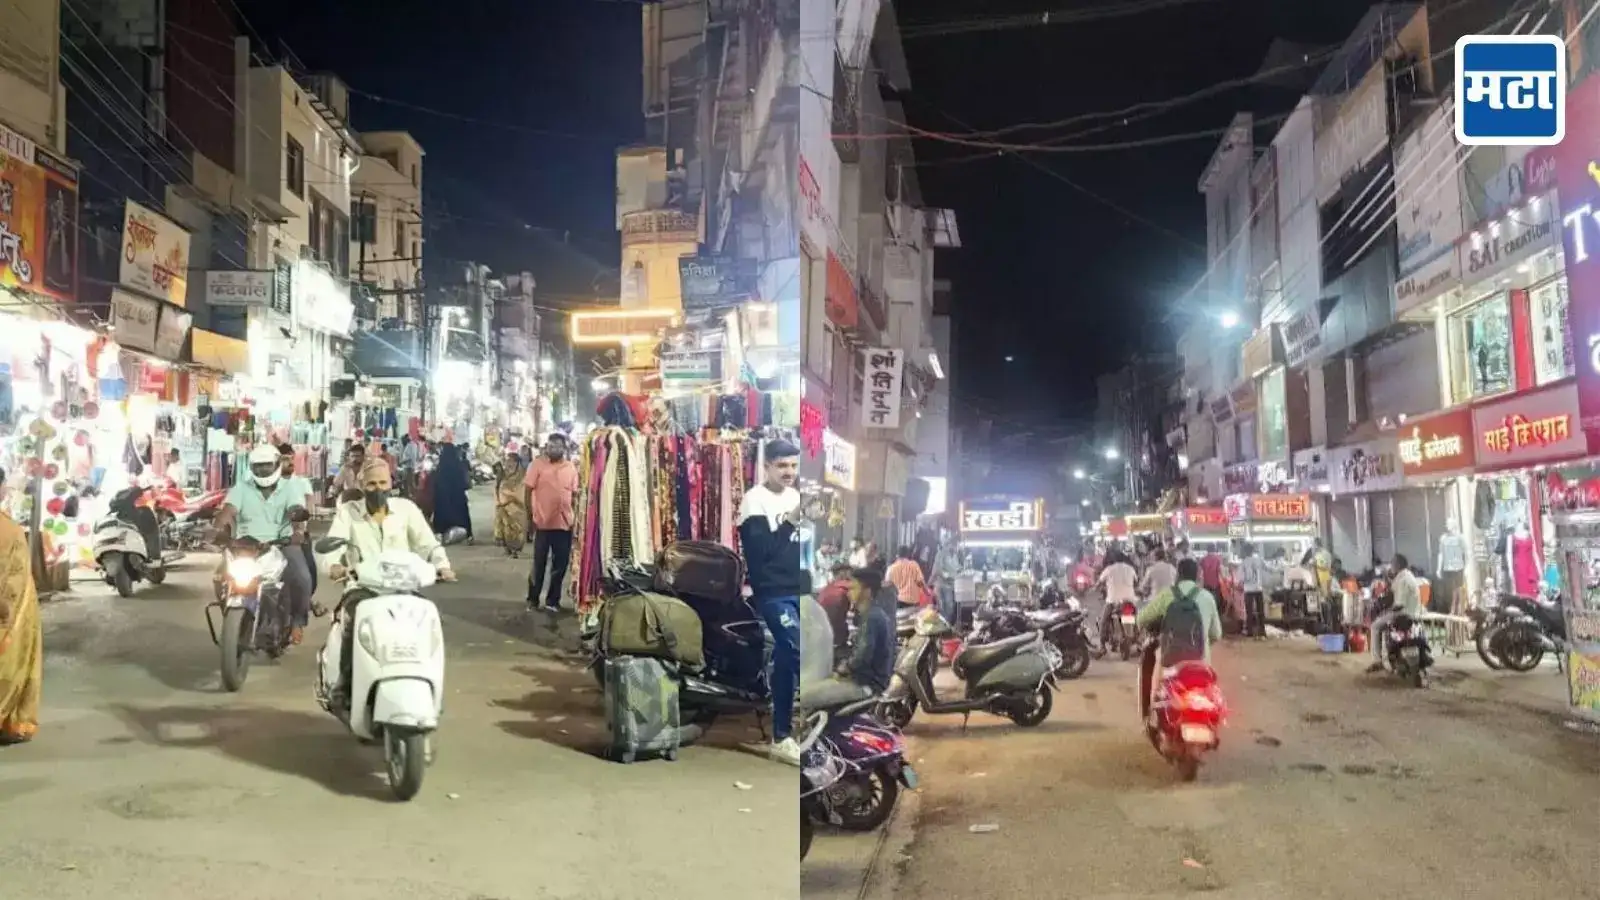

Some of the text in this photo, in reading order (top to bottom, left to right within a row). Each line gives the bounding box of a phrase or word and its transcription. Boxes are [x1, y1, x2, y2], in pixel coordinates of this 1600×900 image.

[1468, 237, 1500, 274] SAI
[869, 350, 897, 425] शांतिदूत
[1484, 417, 1511, 454] साई
